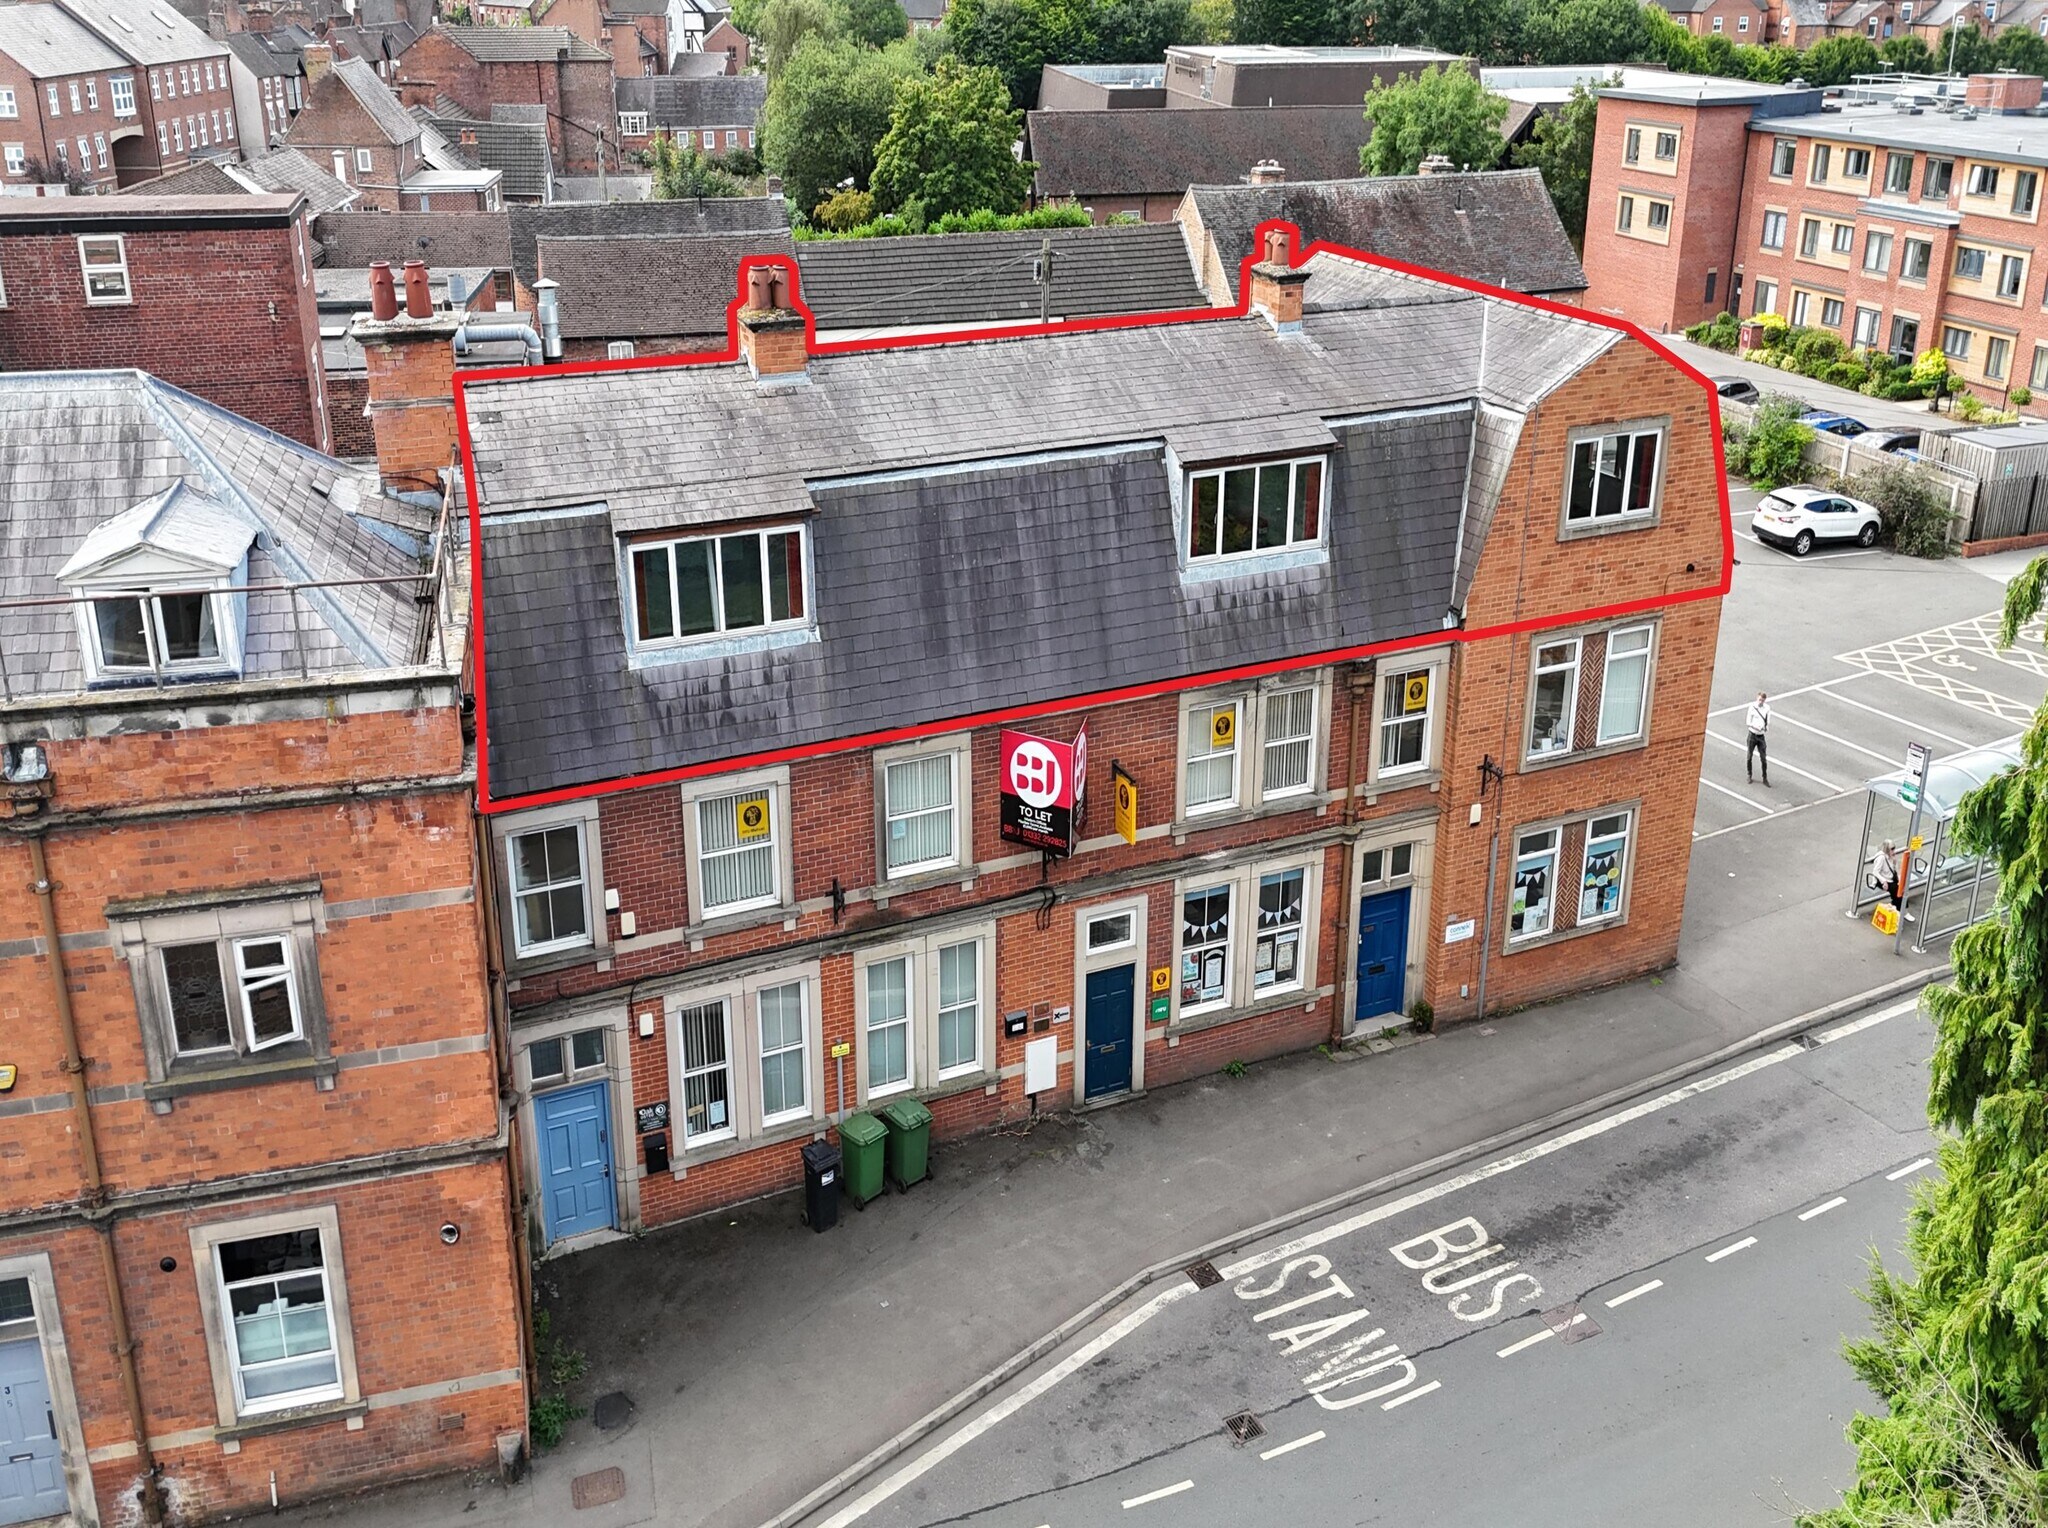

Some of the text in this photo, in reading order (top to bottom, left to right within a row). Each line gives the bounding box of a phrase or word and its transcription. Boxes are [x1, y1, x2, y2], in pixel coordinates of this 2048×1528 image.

[1019, 805, 1033, 817] TO
[1035, 809, 1053, 823] LET
[1389, 1216, 1545, 1321] BUS
[1233, 1254, 1417, 1411] STAND
[4, 1386, 11, 1395] 3
